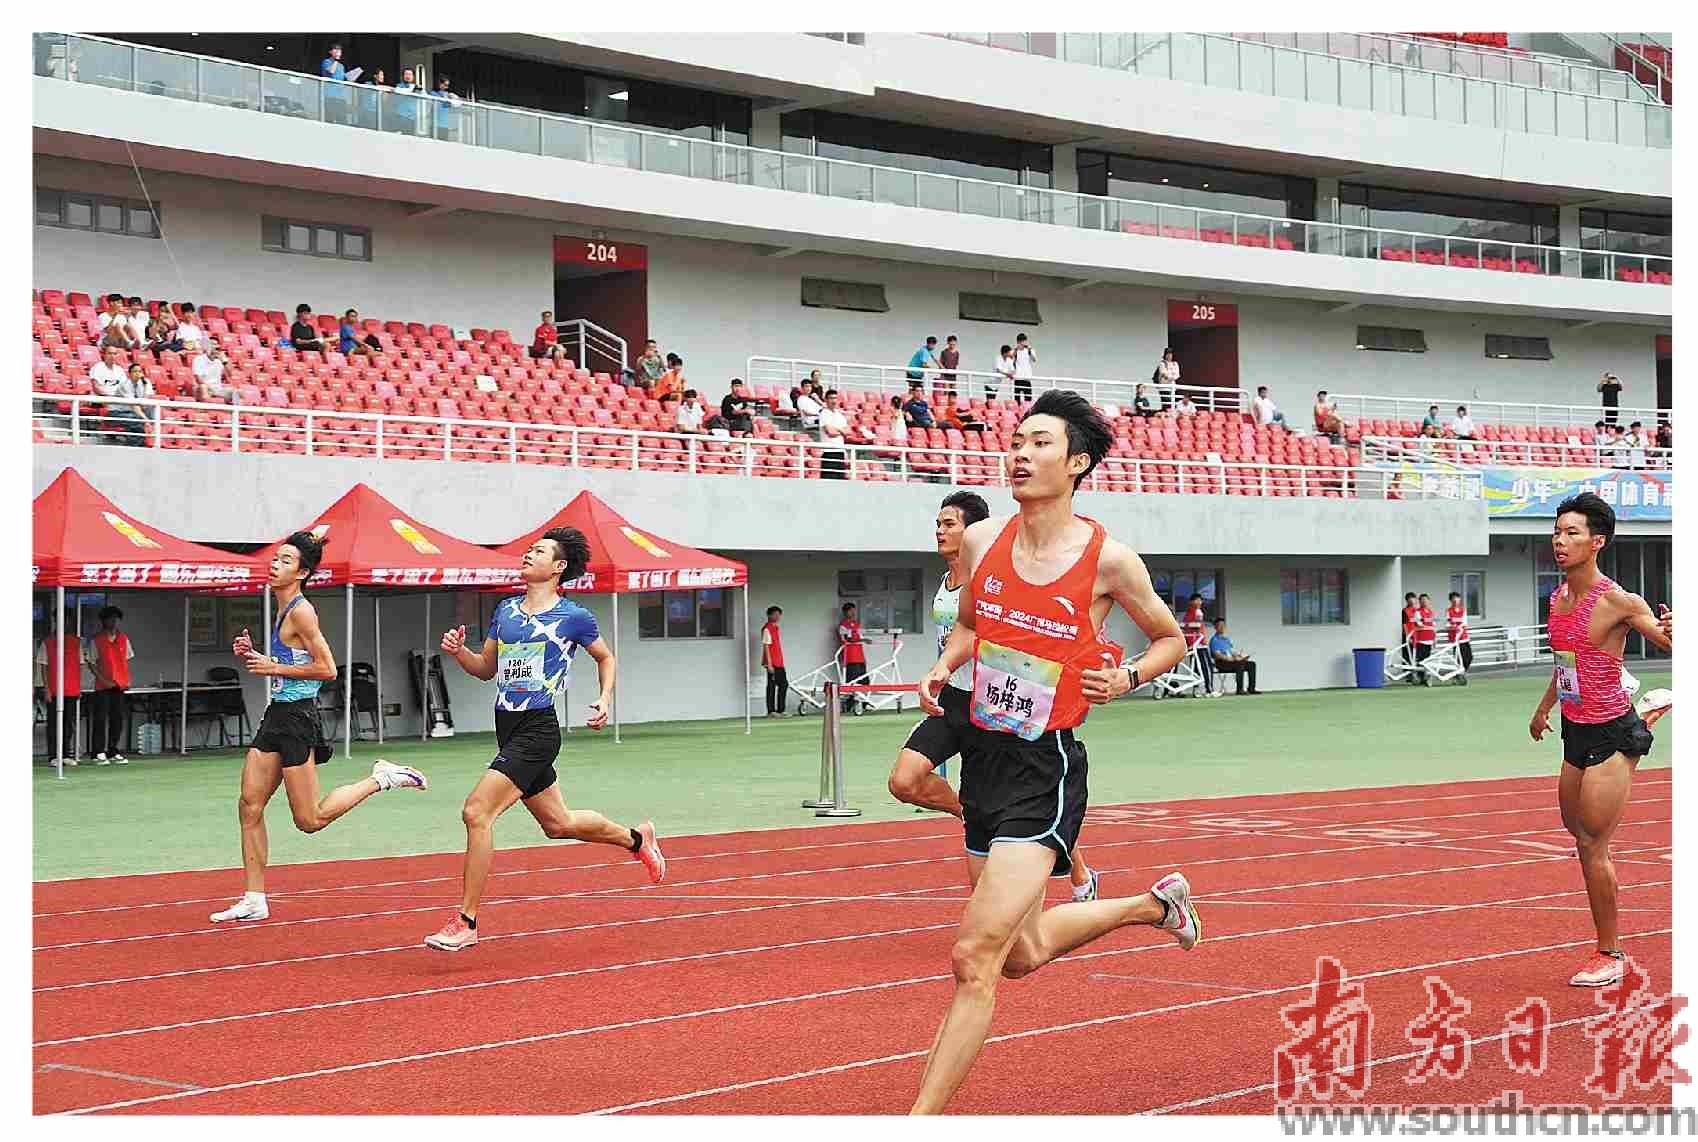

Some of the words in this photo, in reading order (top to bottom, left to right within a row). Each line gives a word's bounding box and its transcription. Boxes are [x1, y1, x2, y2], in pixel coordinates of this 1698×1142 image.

[587, 242, 617, 263] 204
[1192, 305, 1216, 320] 205
[1005, 675, 1018, 692] 16
